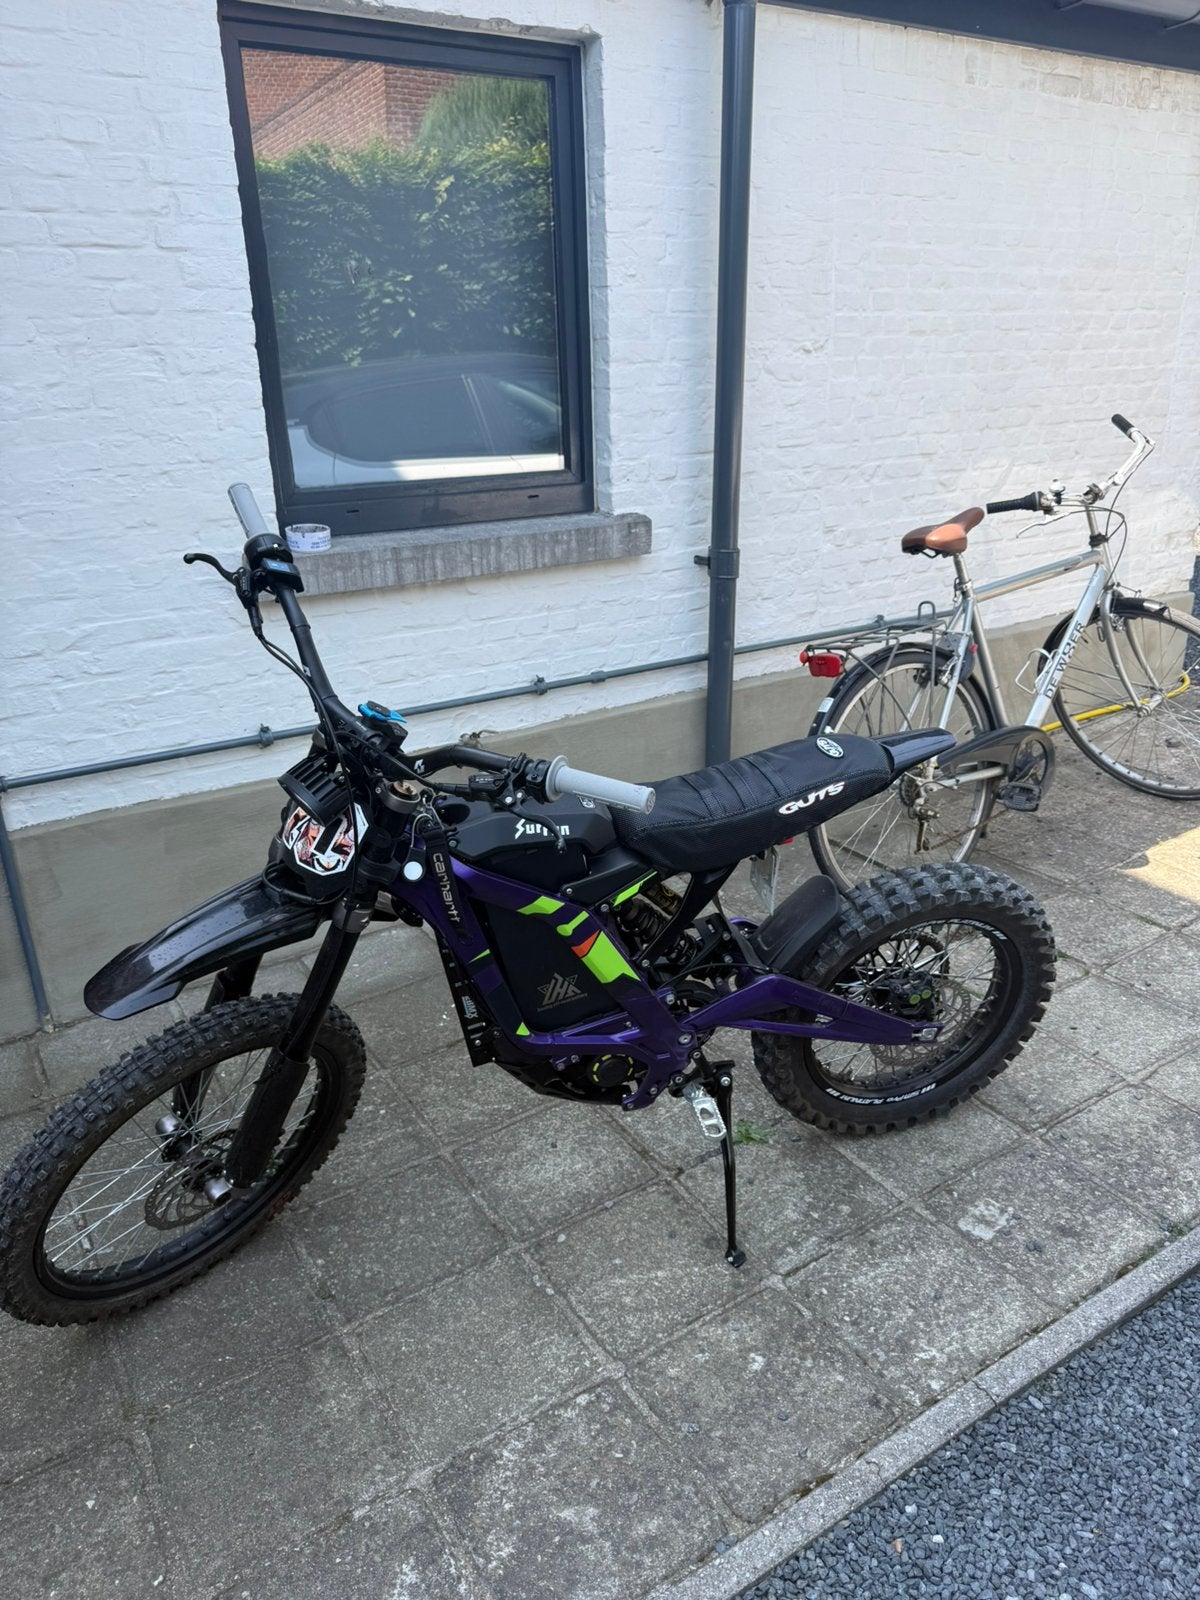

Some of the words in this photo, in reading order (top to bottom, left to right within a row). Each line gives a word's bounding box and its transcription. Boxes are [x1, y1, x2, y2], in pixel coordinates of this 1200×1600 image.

[778, 781, 845, 815] GUTS
[514, 818, 570, 840] Surrn
[432, 852, 461, 923] carhartt
[839, 1094, 885, 1105] PLATINUM
